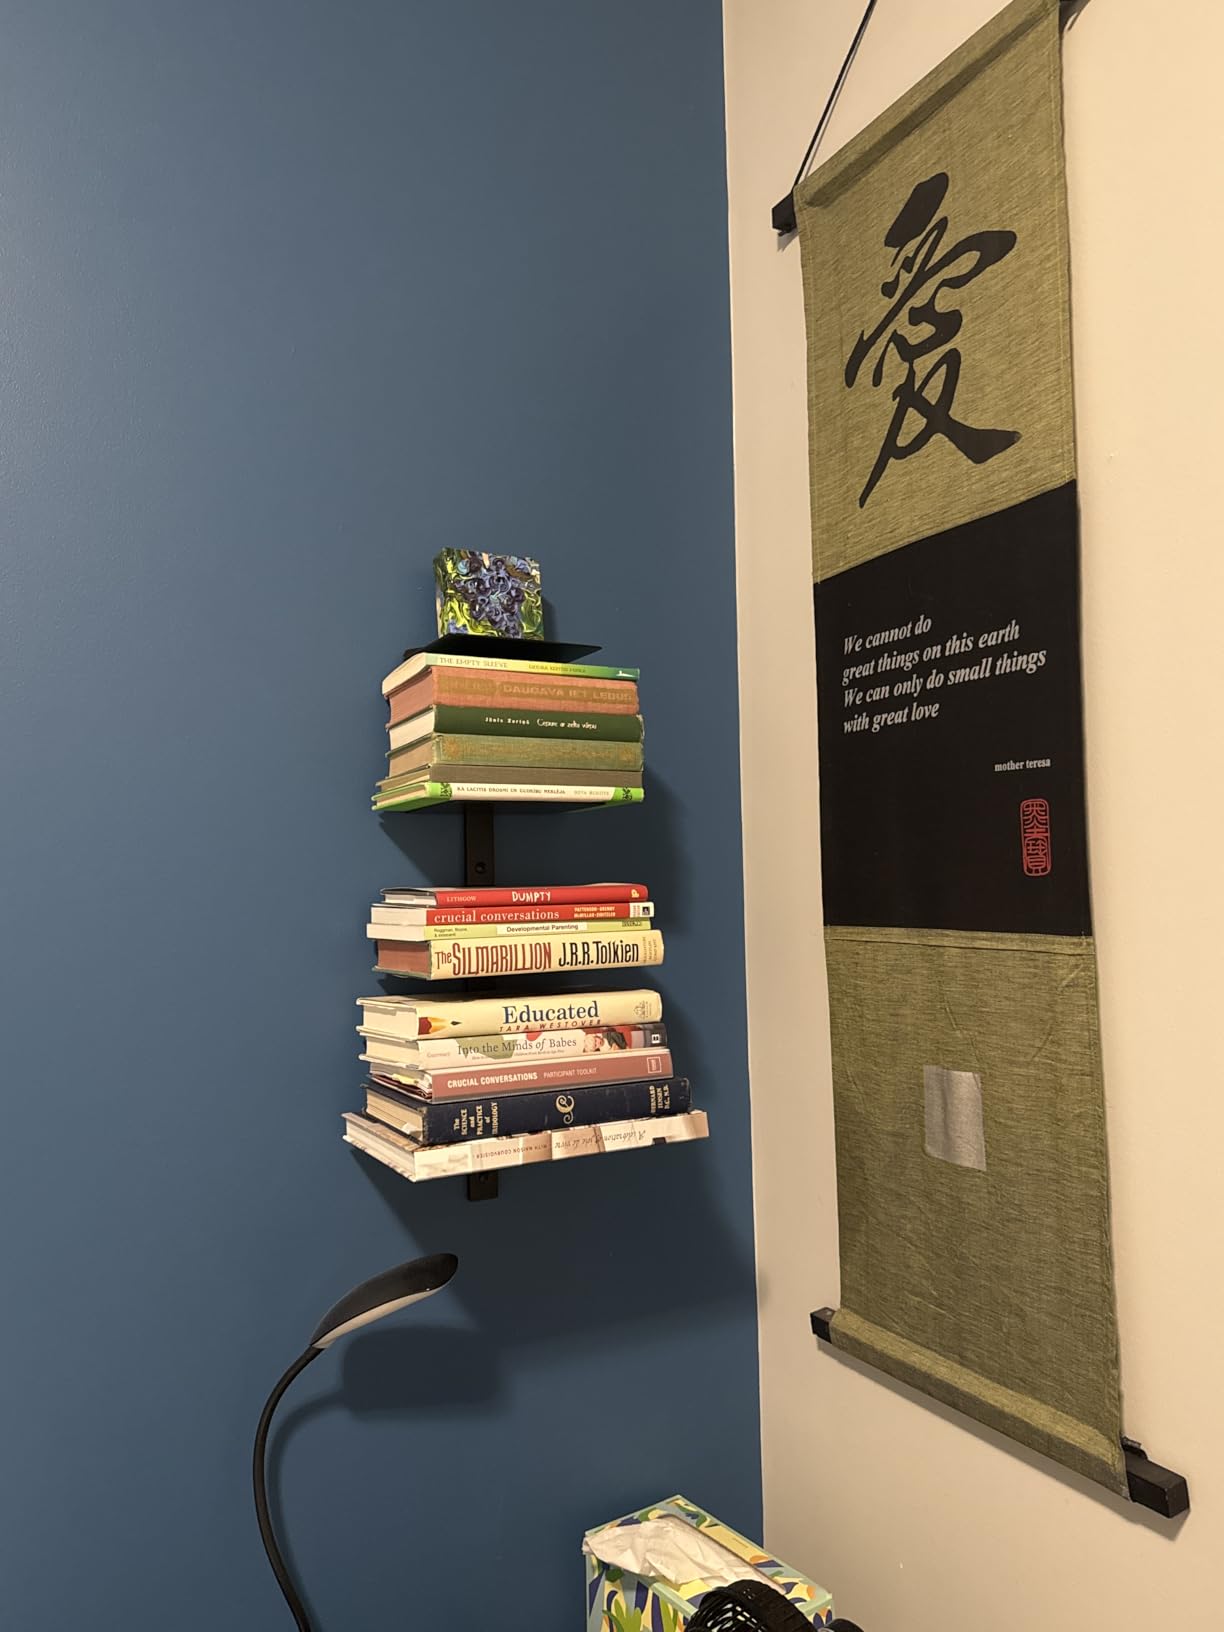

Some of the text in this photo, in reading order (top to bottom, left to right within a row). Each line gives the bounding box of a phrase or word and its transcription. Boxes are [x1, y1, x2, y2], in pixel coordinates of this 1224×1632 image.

[845, 171, 1021, 508] 愛
[843, 614, 932, 655] We cannot do
[842, 618, 1020, 686] great things on this earth
[843, 648, 1047, 708] We can only do small things
[843, 701, 940, 734] with great love
[994, 758, 1051, 772] mother teresa
[512, 891, 551, 902] DUMPTY
[434, 908, 560, 923] crucial conversations
[507, 924, 550, 933] Developmental
[435, 950, 452, 970] The
[452, 941, 552, 976] SILMARILLION
[559, 942, 594, 967] J.R.R.
[592, 939, 640, 965] Tolkien
[503, 1000, 600, 1025] Educated
[500, 1019, 601, 1032] TARA WESTOVER
[457, 1037, 577, 1056] Into the Minds of Babes
[447, 1077, 479, 1088] CRUCIAL
[480, 1072, 538, 1085] CONVERSATIONS
[543, 1069, 575, 1079] PARTICIPANT
[637, 1130, 646, 1141] A
